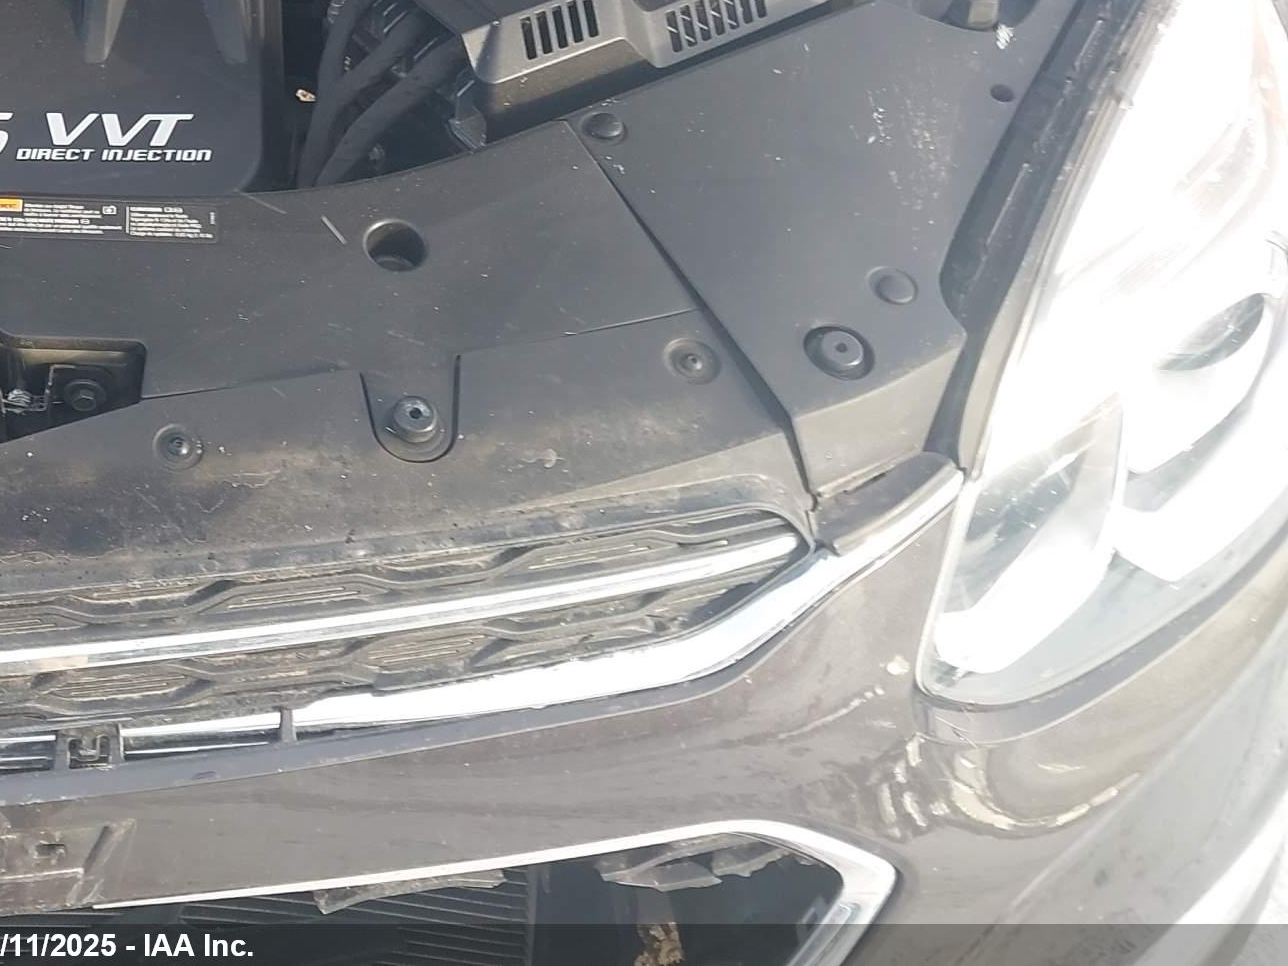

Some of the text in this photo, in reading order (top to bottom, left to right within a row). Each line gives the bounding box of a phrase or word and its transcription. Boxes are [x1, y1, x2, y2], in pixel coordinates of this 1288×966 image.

[45, 112, 194, 147] VVT
[16, 148, 212, 162] DIRECT INJECTION
